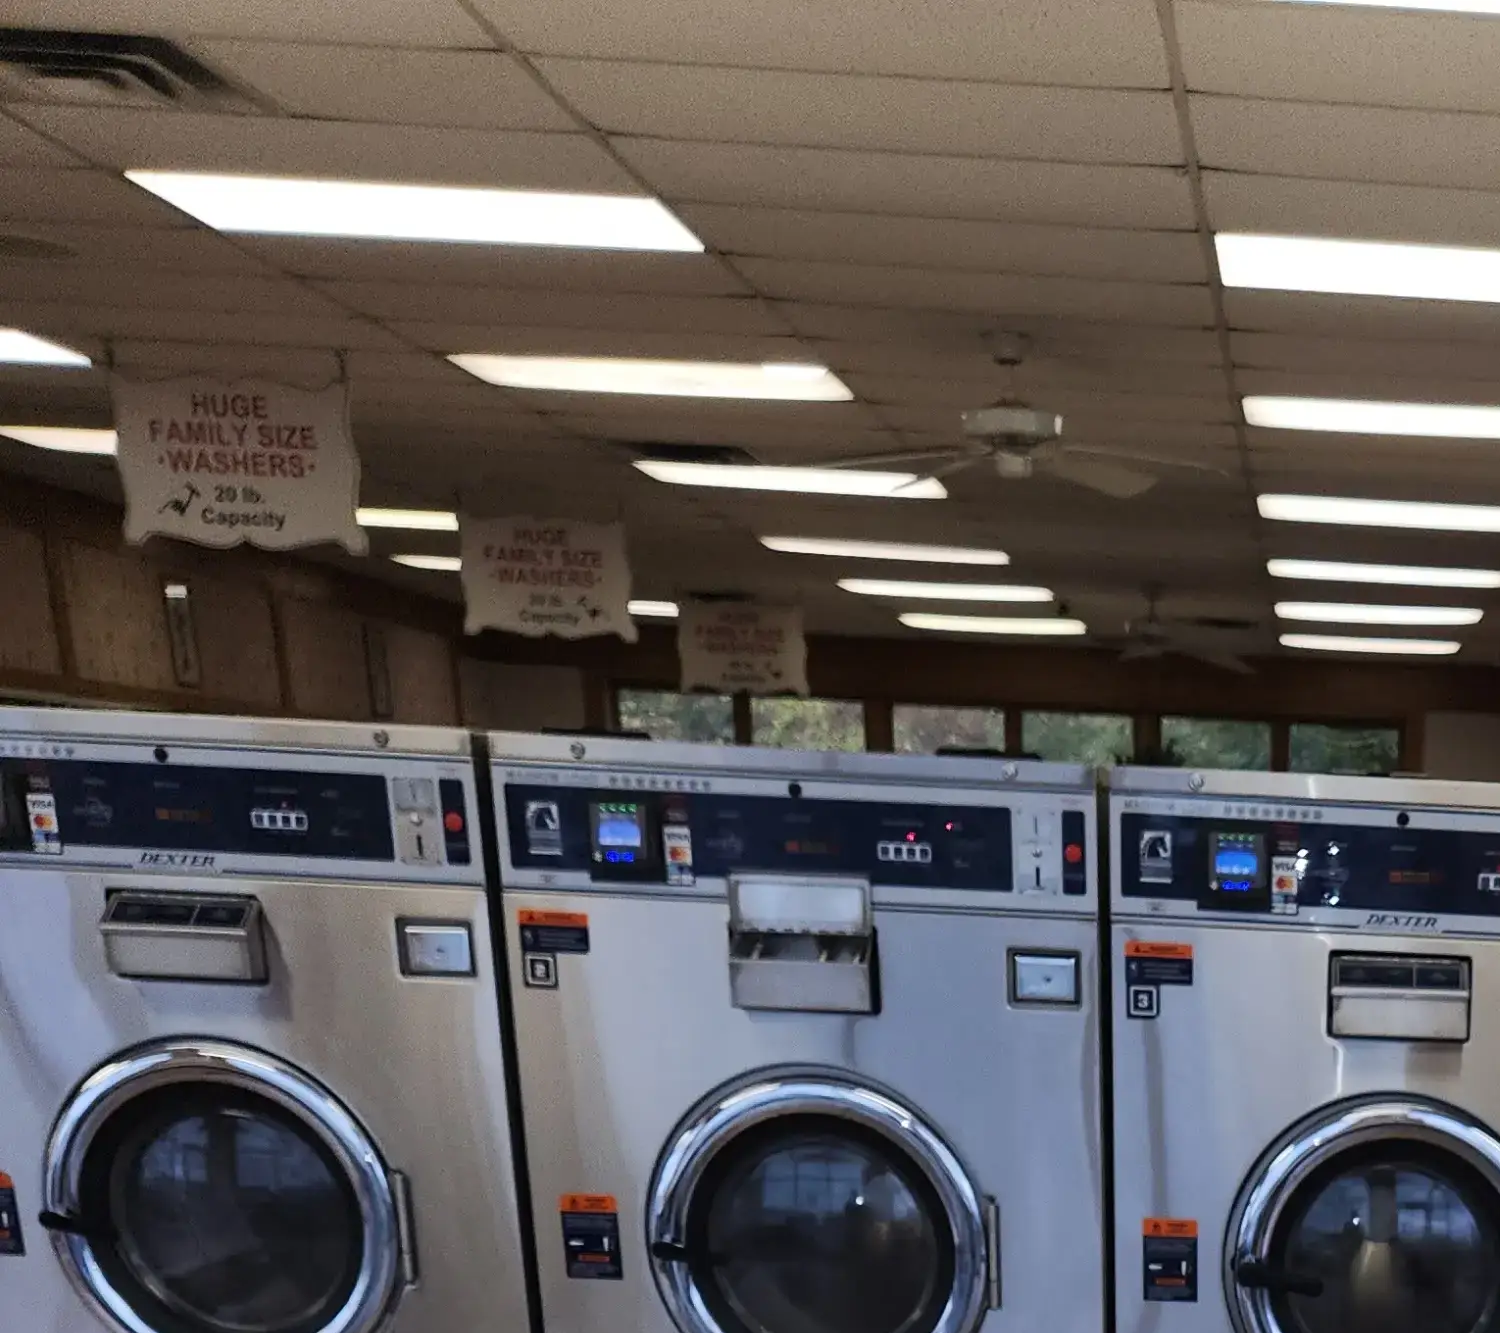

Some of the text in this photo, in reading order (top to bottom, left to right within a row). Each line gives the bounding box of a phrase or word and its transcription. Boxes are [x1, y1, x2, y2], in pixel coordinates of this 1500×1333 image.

[191, 391, 268, 419] HUGE
[148, 419, 317, 450] FAMILY SIZE
[213, 485, 238, 503] 20
[201, 507, 285, 531] Capacity
[140, 852, 216, 867] DEXTER
[1366, 914, 1439, 929] DEXTER
[1137, 993, 1149, 1008] 3
